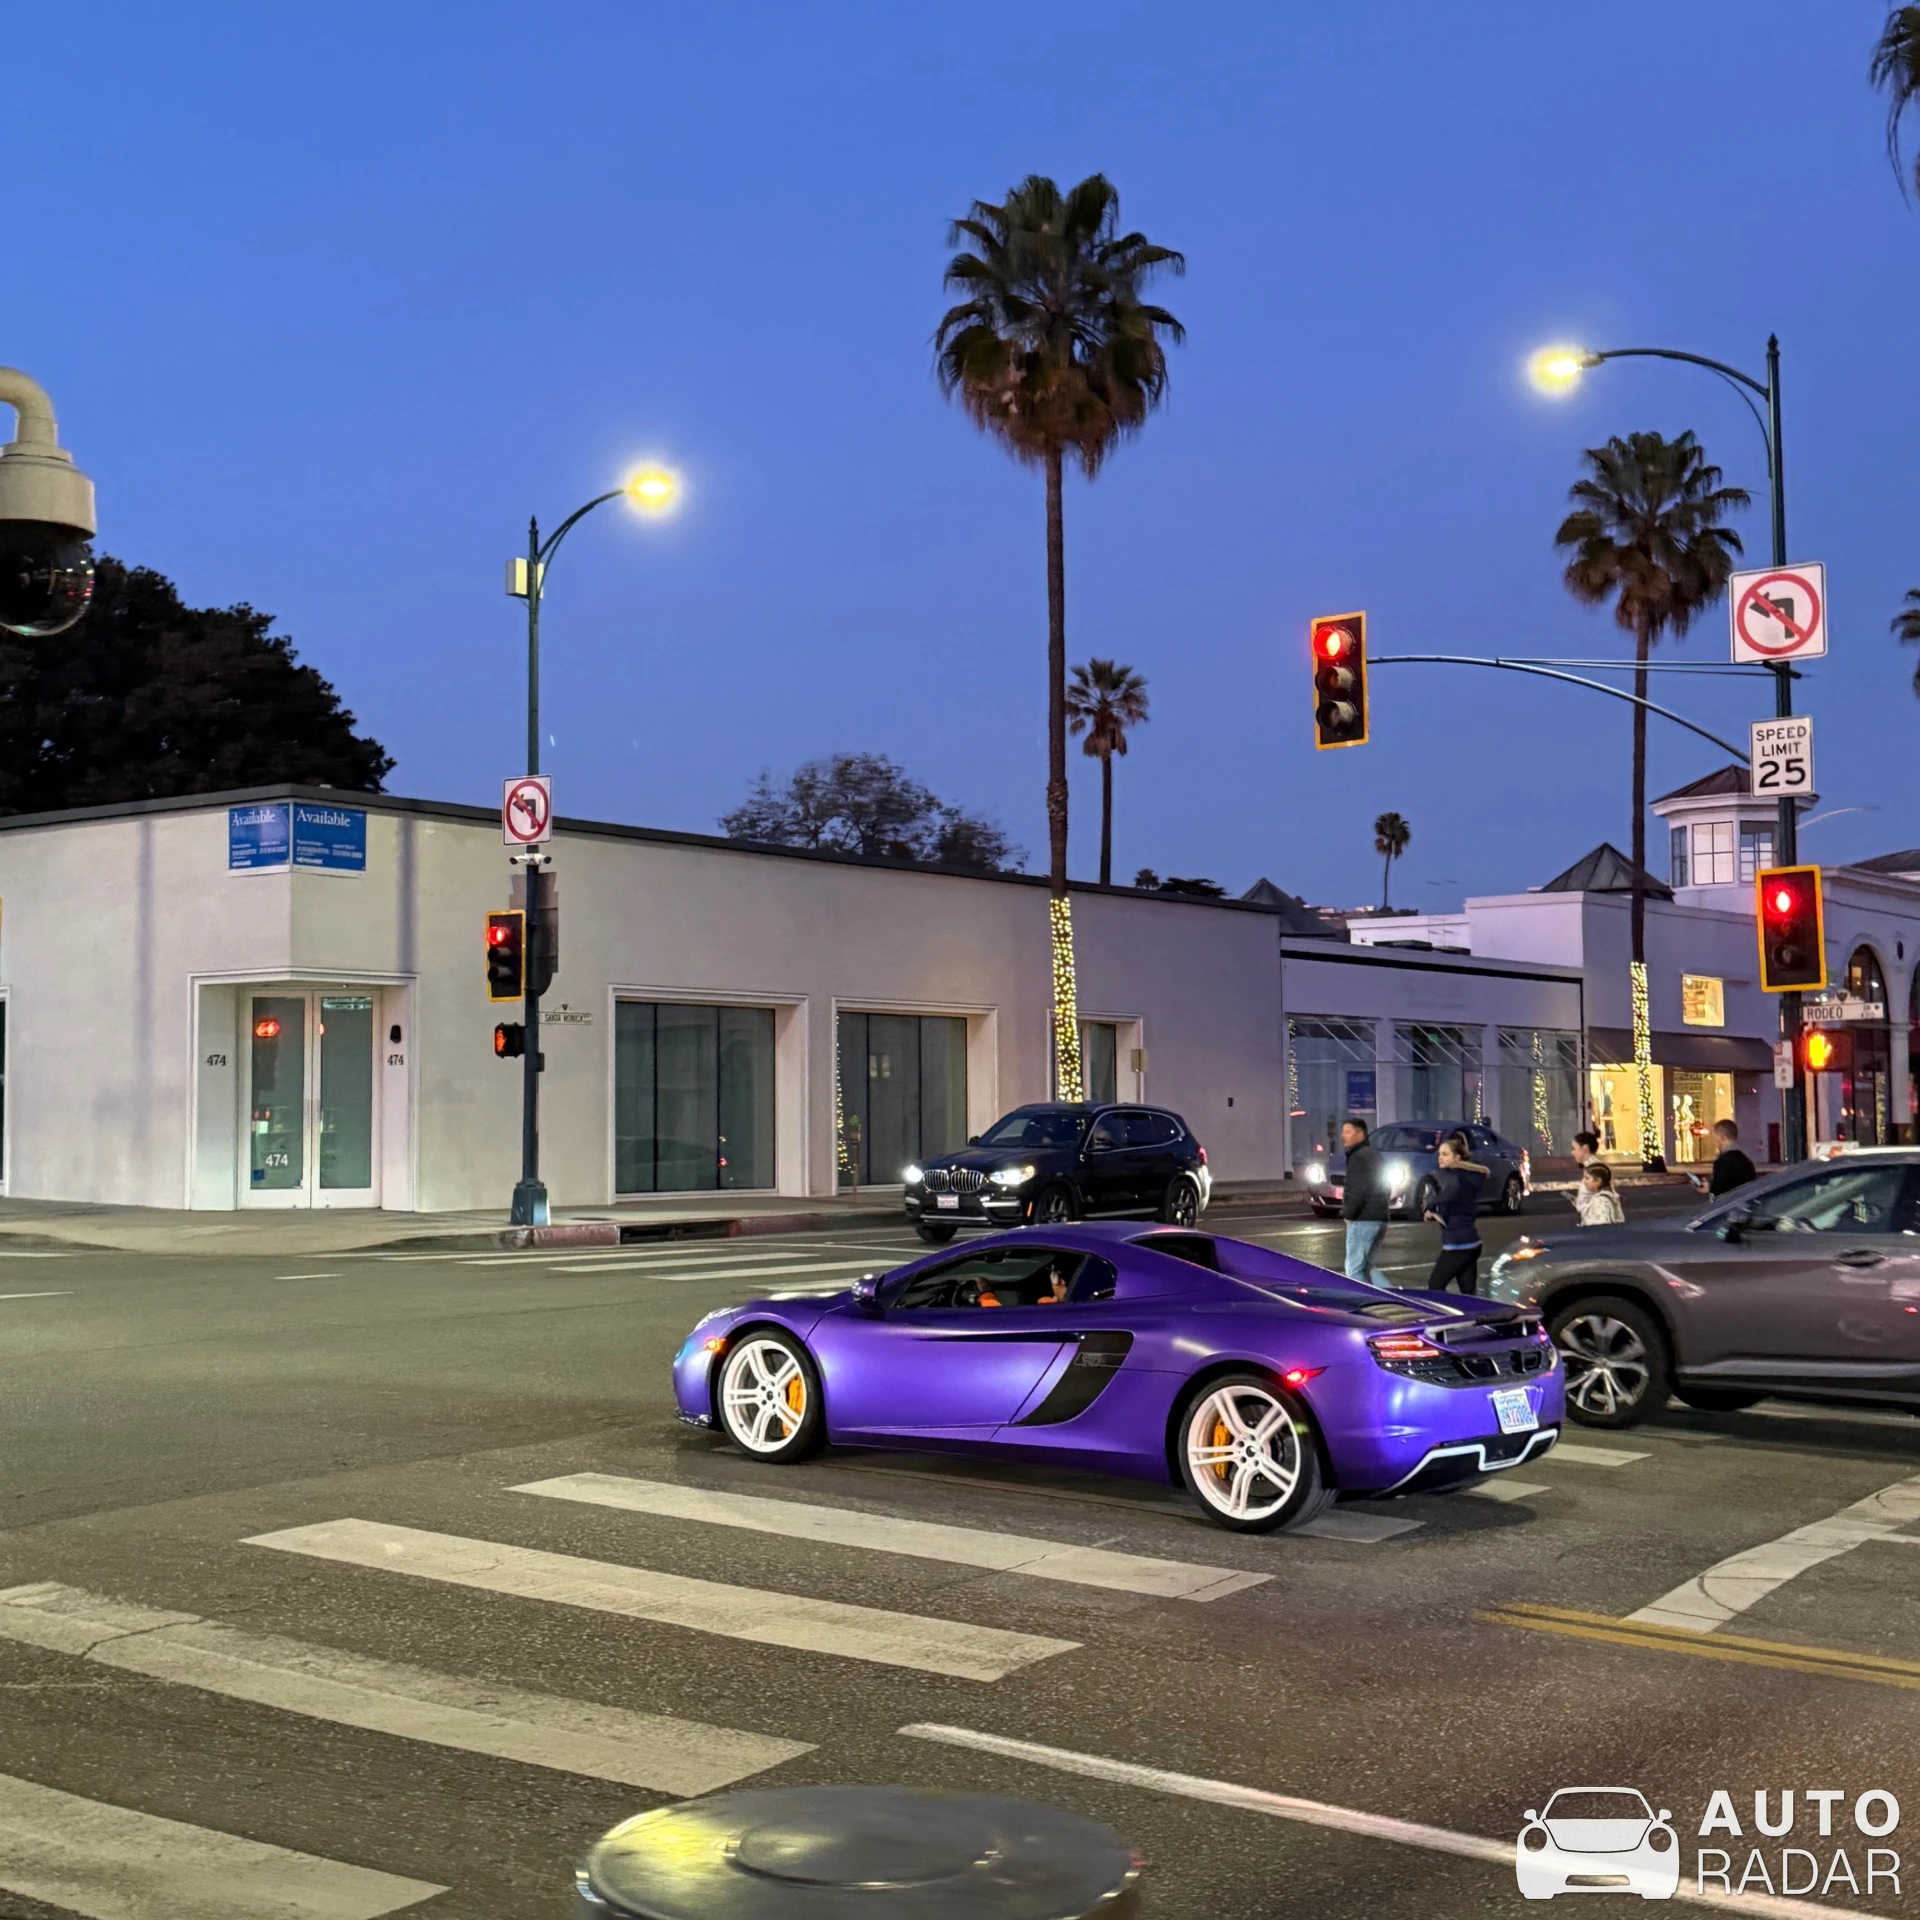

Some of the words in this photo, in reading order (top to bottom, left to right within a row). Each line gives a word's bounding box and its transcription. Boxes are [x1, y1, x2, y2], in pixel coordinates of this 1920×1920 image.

[1756, 726, 1807, 741] SPEED
[1762, 742, 1801, 757] LIMIT
[1759, 758, 1806, 788] 25
[232, 809, 276, 827] Available
[297, 809, 351, 827] Available
[1807, 1006, 1843, 1019] RODEO
[206, 1055, 227, 1066] 474
[387, 1055, 404, 1065] 474
[265, 1154, 289, 1167] 474
